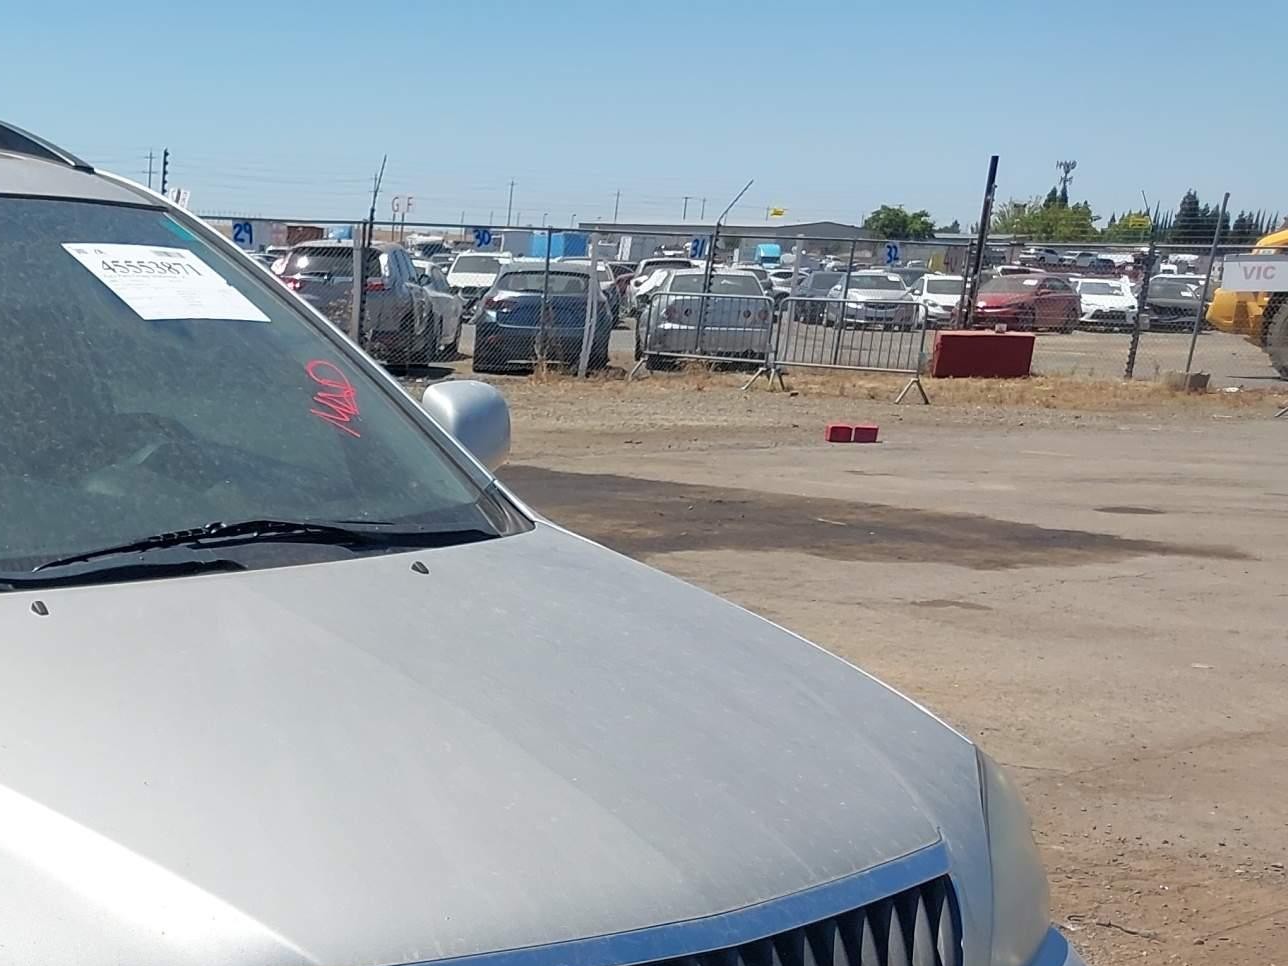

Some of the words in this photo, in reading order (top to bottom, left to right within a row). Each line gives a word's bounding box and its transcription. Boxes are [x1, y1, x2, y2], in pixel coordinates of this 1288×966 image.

[233, 222, 253, 244] 29
[473, 229, 491, 247] 30
[691, 239, 705, 258] 31
[886, 244, 899, 264] 32
[101, 260, 202, 276] 45553871
[1243, 265, 1276, 280] VIC
